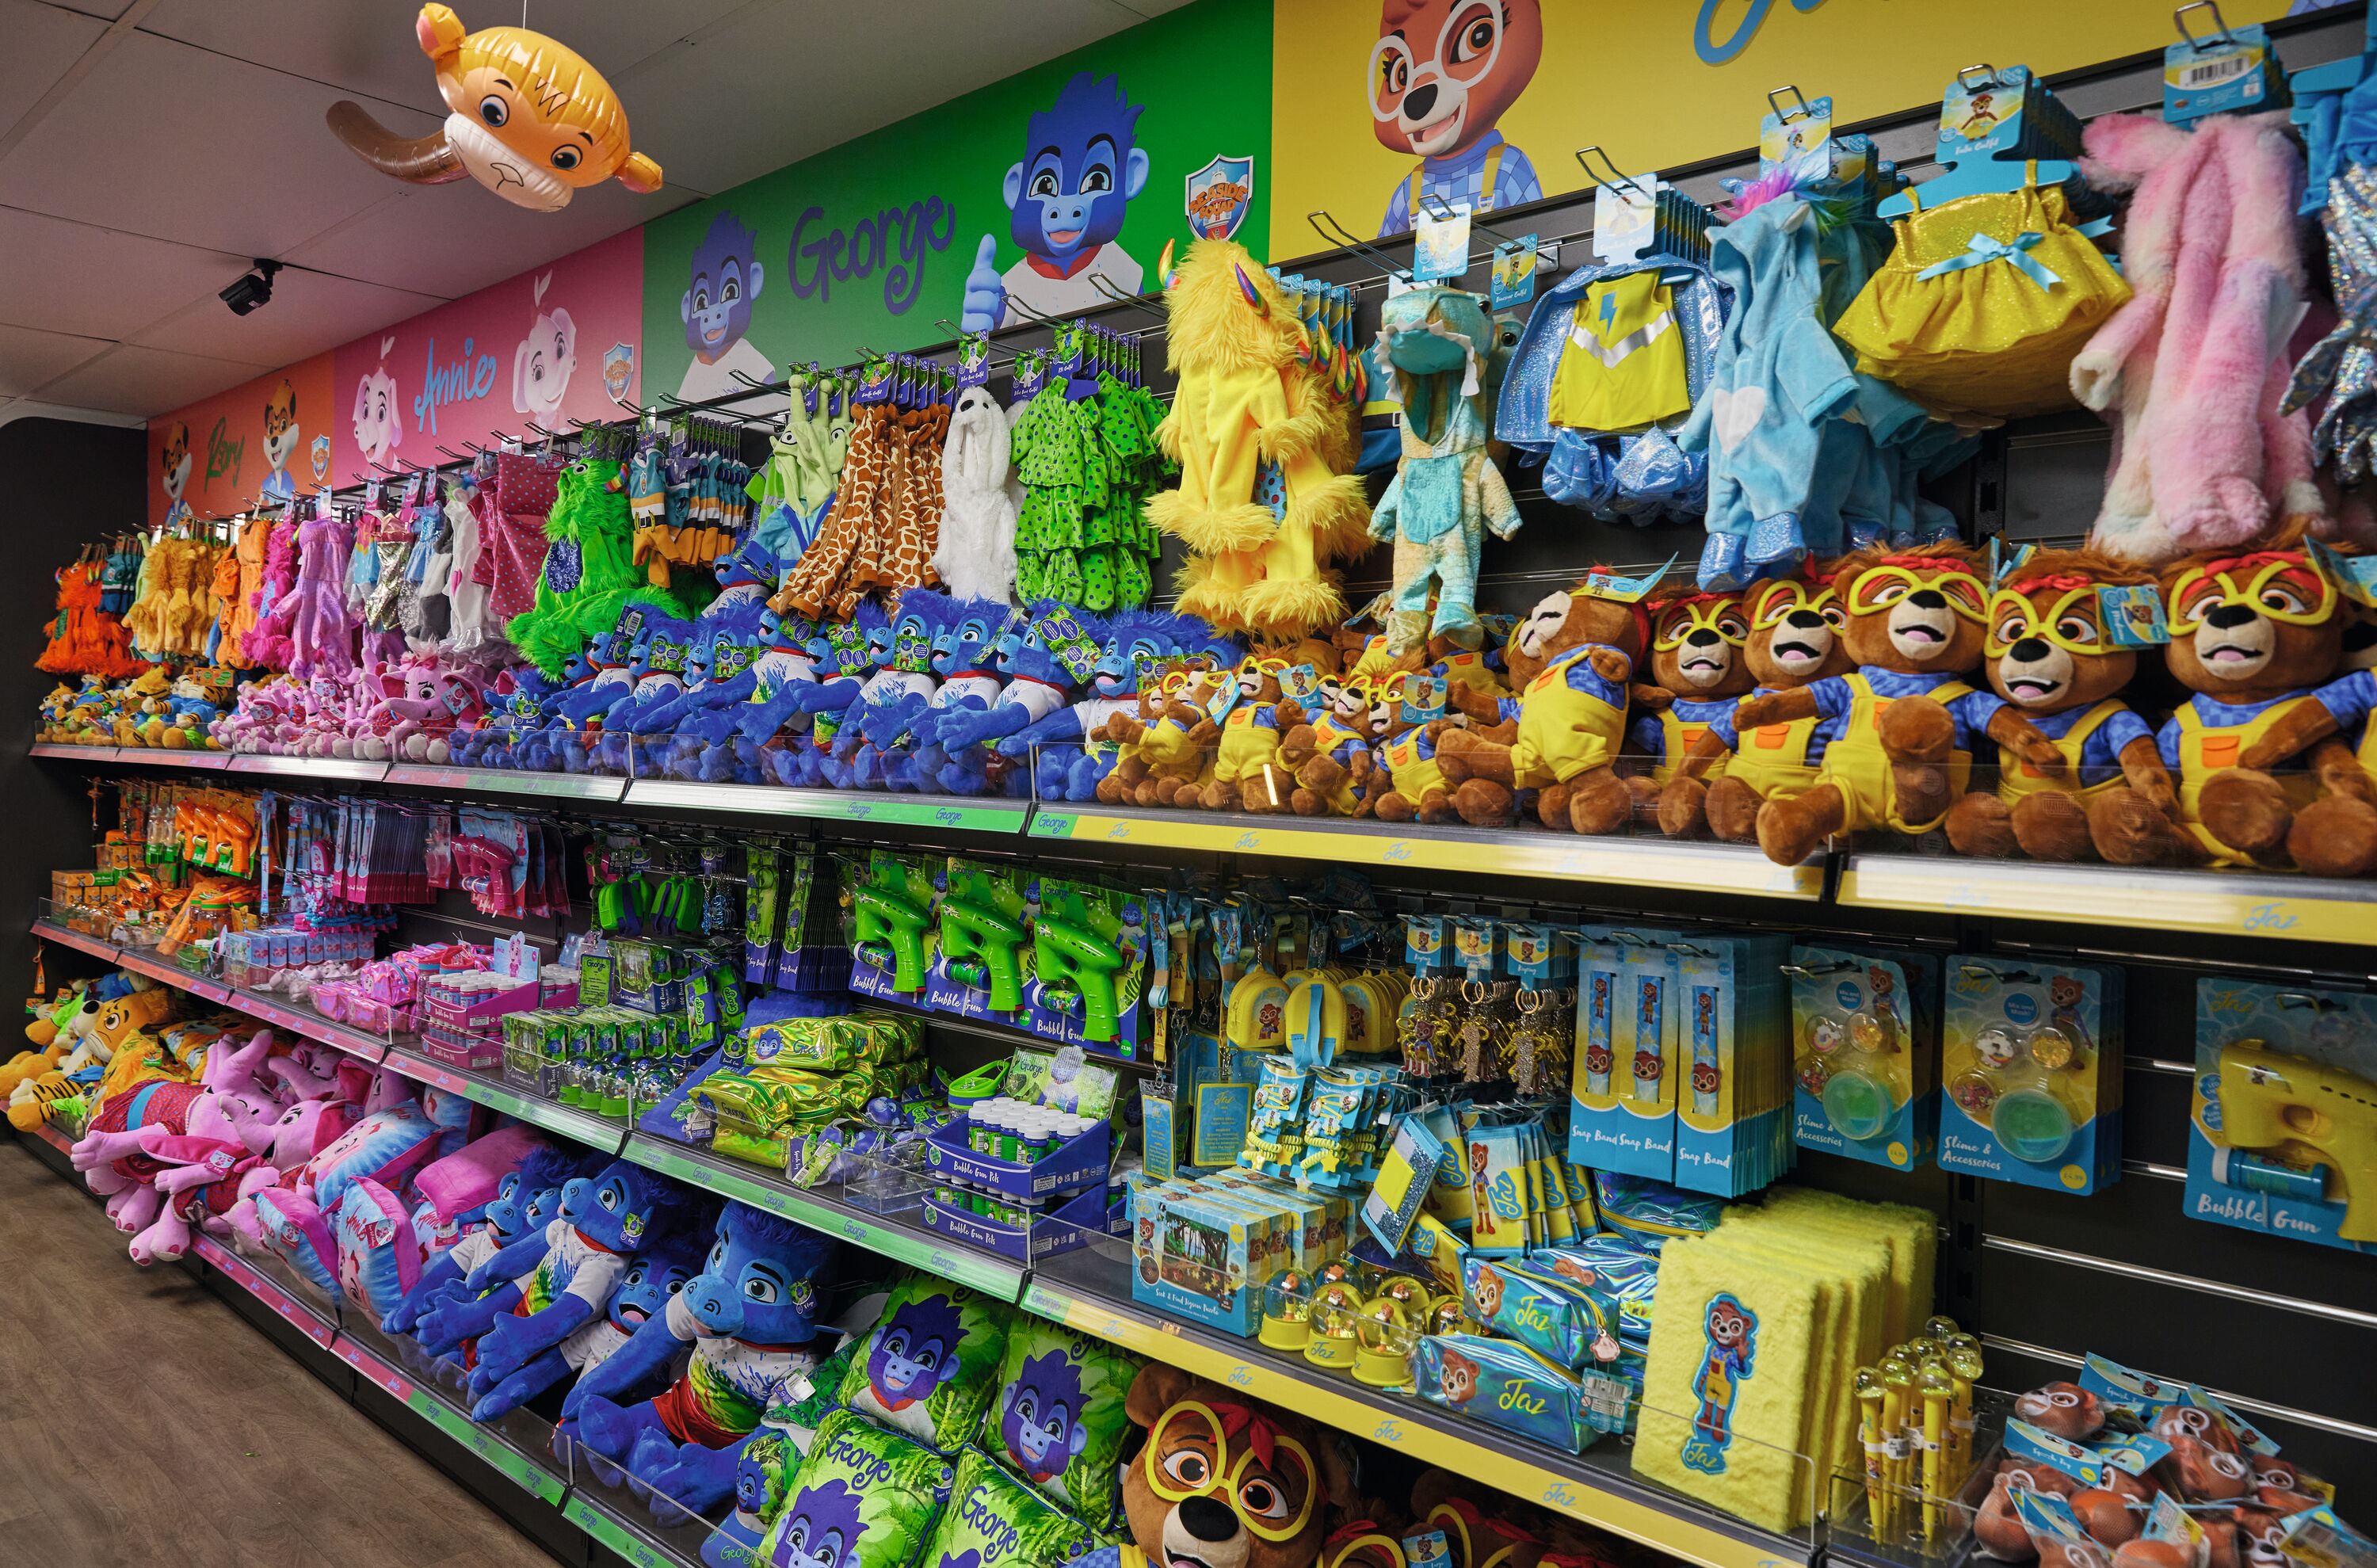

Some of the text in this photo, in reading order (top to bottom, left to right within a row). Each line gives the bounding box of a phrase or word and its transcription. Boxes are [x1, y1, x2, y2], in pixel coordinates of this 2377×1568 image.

[1189, 183, 1248, 215] SEASIDE
[1198, 200, 1236, 219] SQUAD
[788, 194, 956, 315] George
[414, 336, 497, 436] Annie
[204, 416, 246, 495] Rory
[1421, 712, 1438, 720] Small
[847, 802, 872, 823] George
[935, 808, 963, 830] George
[1038, 814, 1069, 835] George
[1108, 822, 1131, 838] Jaz
[1234, 832, 1261, 849] Jaz
[1383, 842, 1414, 861] Jaz
[1044, 883, 1070, 902] George
[2243, 902, 2304, 931] Jaz
[586, 959, 606, 972] George
[931, 990, 960, 1009] Bubble
[694, 996, 705, 1026] George
[1120, 1044, 1131, 1053] £5.99
[1021, 1059, 1044, 1080] George
[1797, 1113, 1826, 1131] Slime
[1572, 1124, 1617, 1146] Snap Band
[1620, 1133, 1671, 1155] Snap Band
[1796, 1127, 1843, 1148] Accessories
[1944, 1135, 1991, 1154] Slime &
[1680, 1147, 1731, 1170] Snap Band
[1942, 1151, 2002, 1171] Accessories
[692, 1166, 712, 1184] George
[953, 1160, 1000, 1184] Bubble Gun Pots
[764, 1191, 786, 1211] George
[1490, 1173, 1520, 1218] Jaz
[345, 1204, 368, 1242] Annie
[2197, 1194, 2321, 1234] Bubble Gun
[844, 1220, 867, 1241] George
[949, 1220, 996, 1246] Bubble Gun Pots
[932, 1250, 958, 1275] George
[1031, 1289, 1060, 1314] George
[1172, 1293, 1184, 1304] Find
[1185, 1298, 1202, 1310] Jigsaw
[1203, 1303, 1219, 1315] Puzzle
[1515, 1295, 1550, 1333] Jaz
[1311, 1341, 1335, 1360] Jaz
[1227, 1366, 1253, 1387] Jaz
[1498, 1379, 1549, 1415] Jaz
[1374, 1420, 1404, 1443] Jaz
[826, 1430, 892, 1490] George
[1686, 1442, 1718, 1469] Jaz
[525, 1466, 543, 1488] George
[1543, 1483, 1577, 1507] Jaz
[579, 1506, 597, 1528] George
[961, 1486, 1020, 1563] George
[635, 1544, 655, 1567] George
